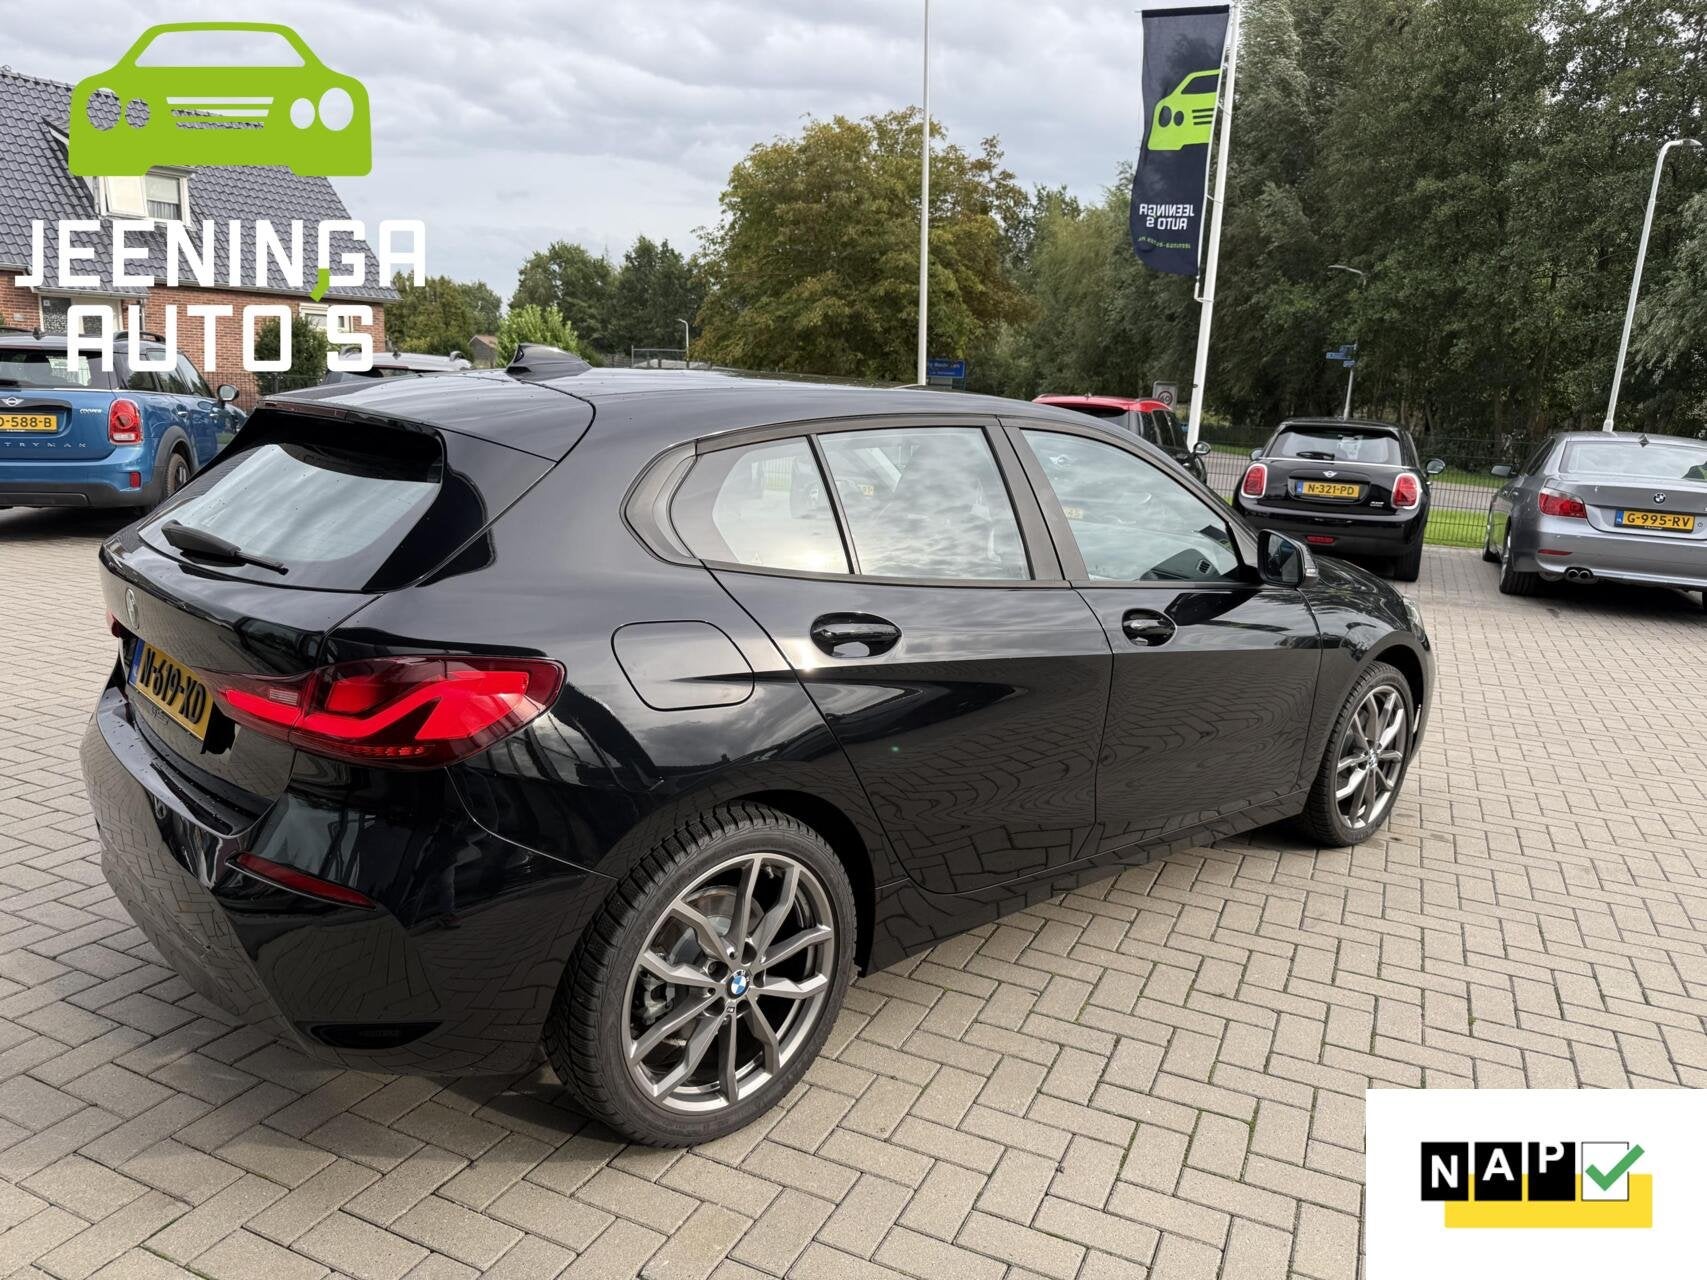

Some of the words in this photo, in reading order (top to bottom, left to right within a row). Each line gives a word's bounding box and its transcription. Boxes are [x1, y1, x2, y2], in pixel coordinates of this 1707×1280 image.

[1307, 483, 1355, 496] N-321-PD
[1627, 513, 1691, 527] G-995-RV
[139, 647, 207, 725] N-619-XD
